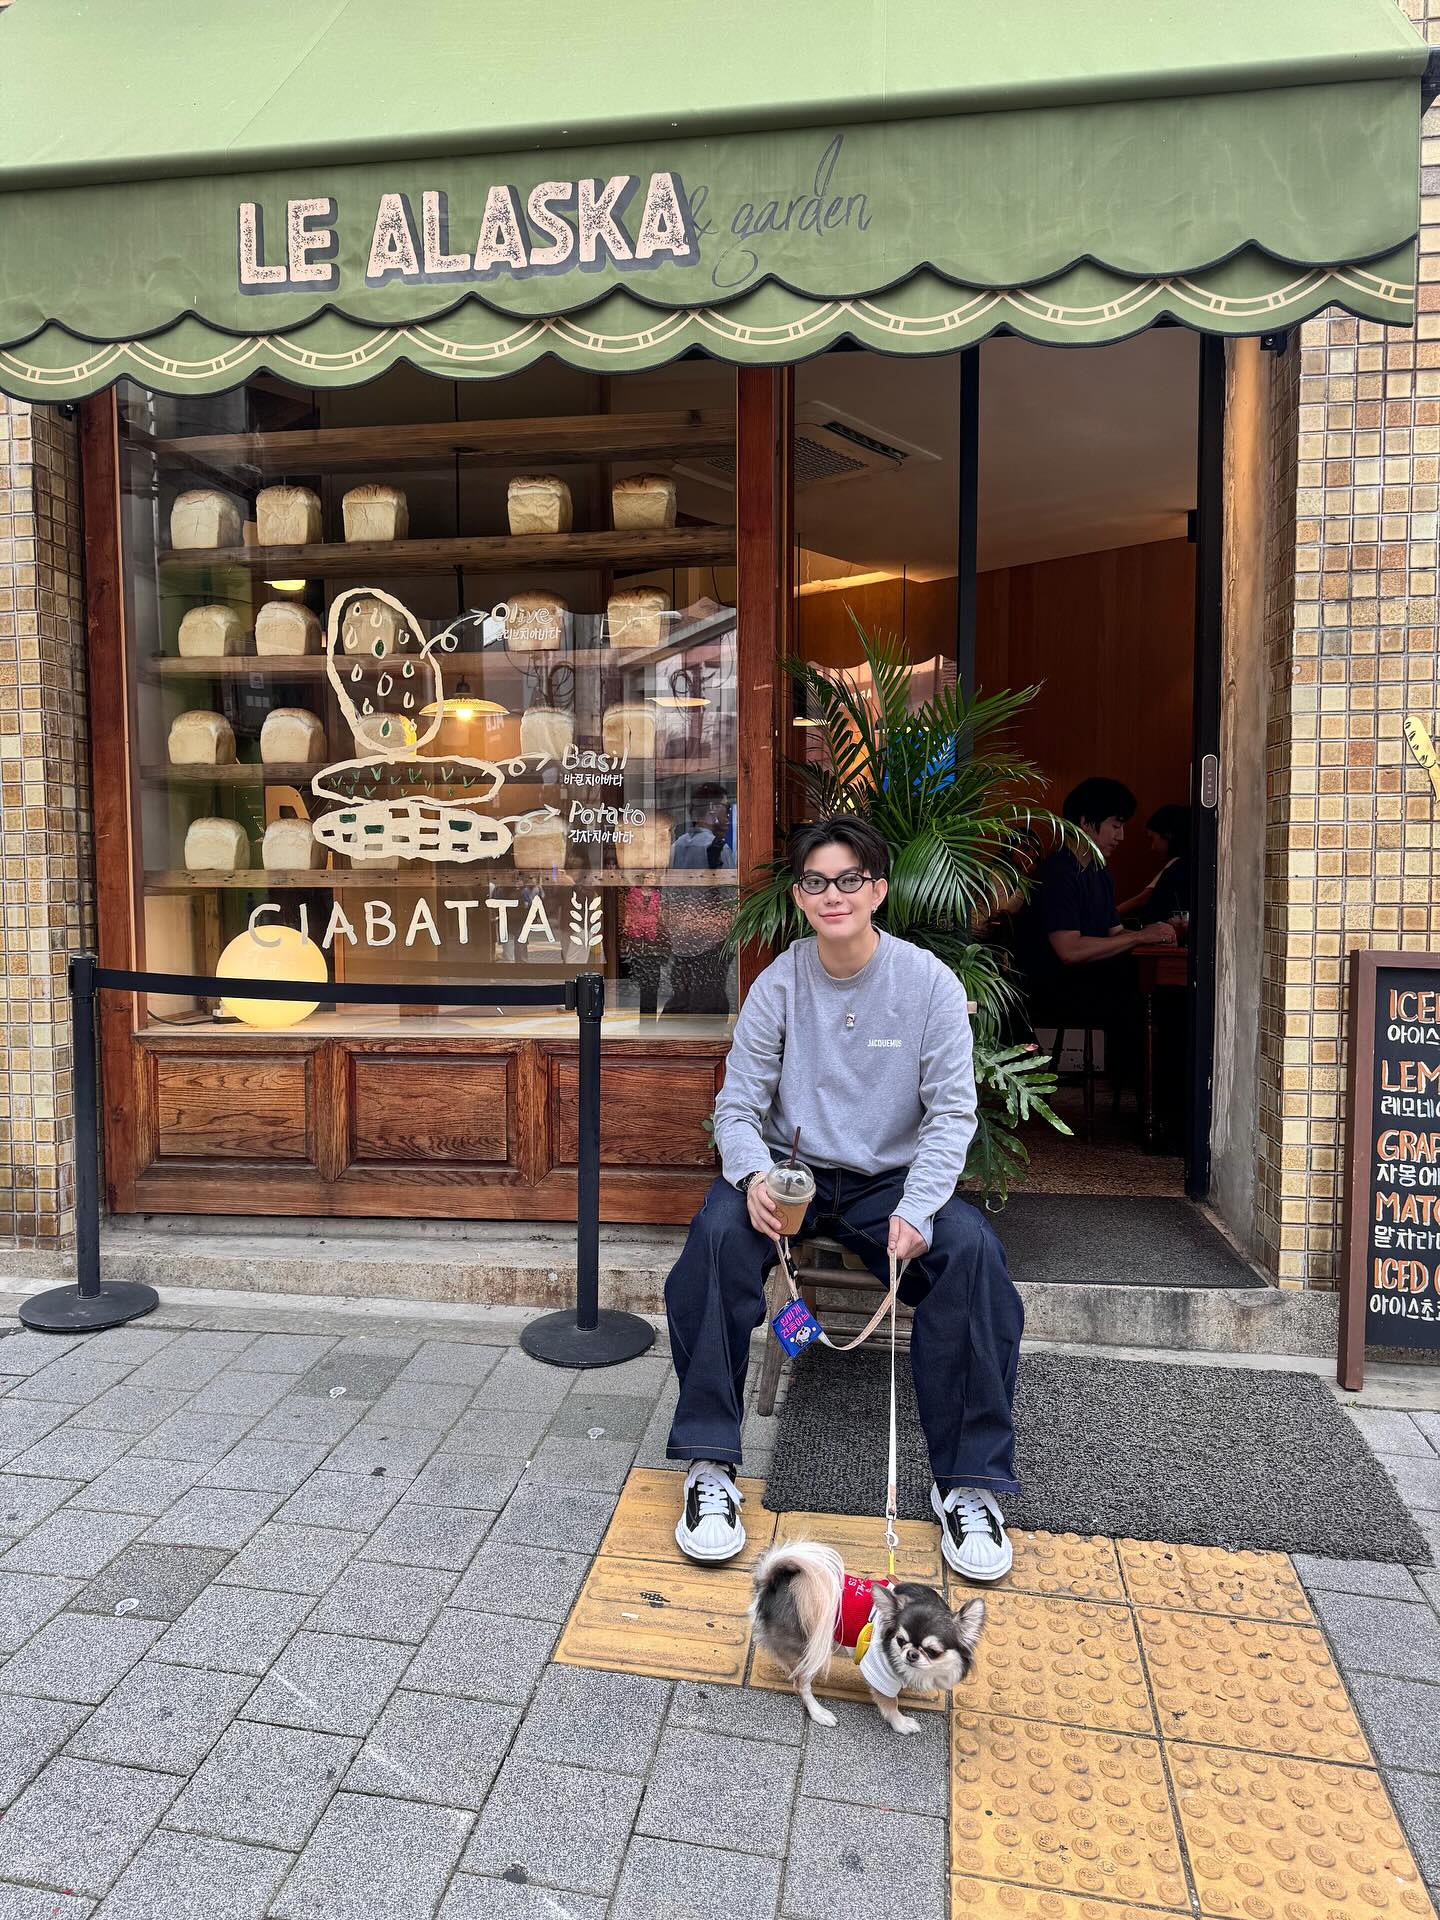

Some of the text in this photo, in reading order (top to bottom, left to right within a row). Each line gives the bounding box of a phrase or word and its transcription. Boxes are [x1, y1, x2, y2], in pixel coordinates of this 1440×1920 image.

[238, 198, 337, 292] LE
[365, 172, 697, 284] ALASKA
[711, 133, 873, 288] garden
[491, 602, 553, 625] Olive
[562, 743, 628, 772] Basil
[569, 800, 646, 826] Potato
[248, 895, 556, 949] CIABATTA
[1380, 1095, 1440, 1119] 레모네
[1374, 1225, 1440, 1249] 말차라
[1374, 1257, 1429, 1294] ICED
